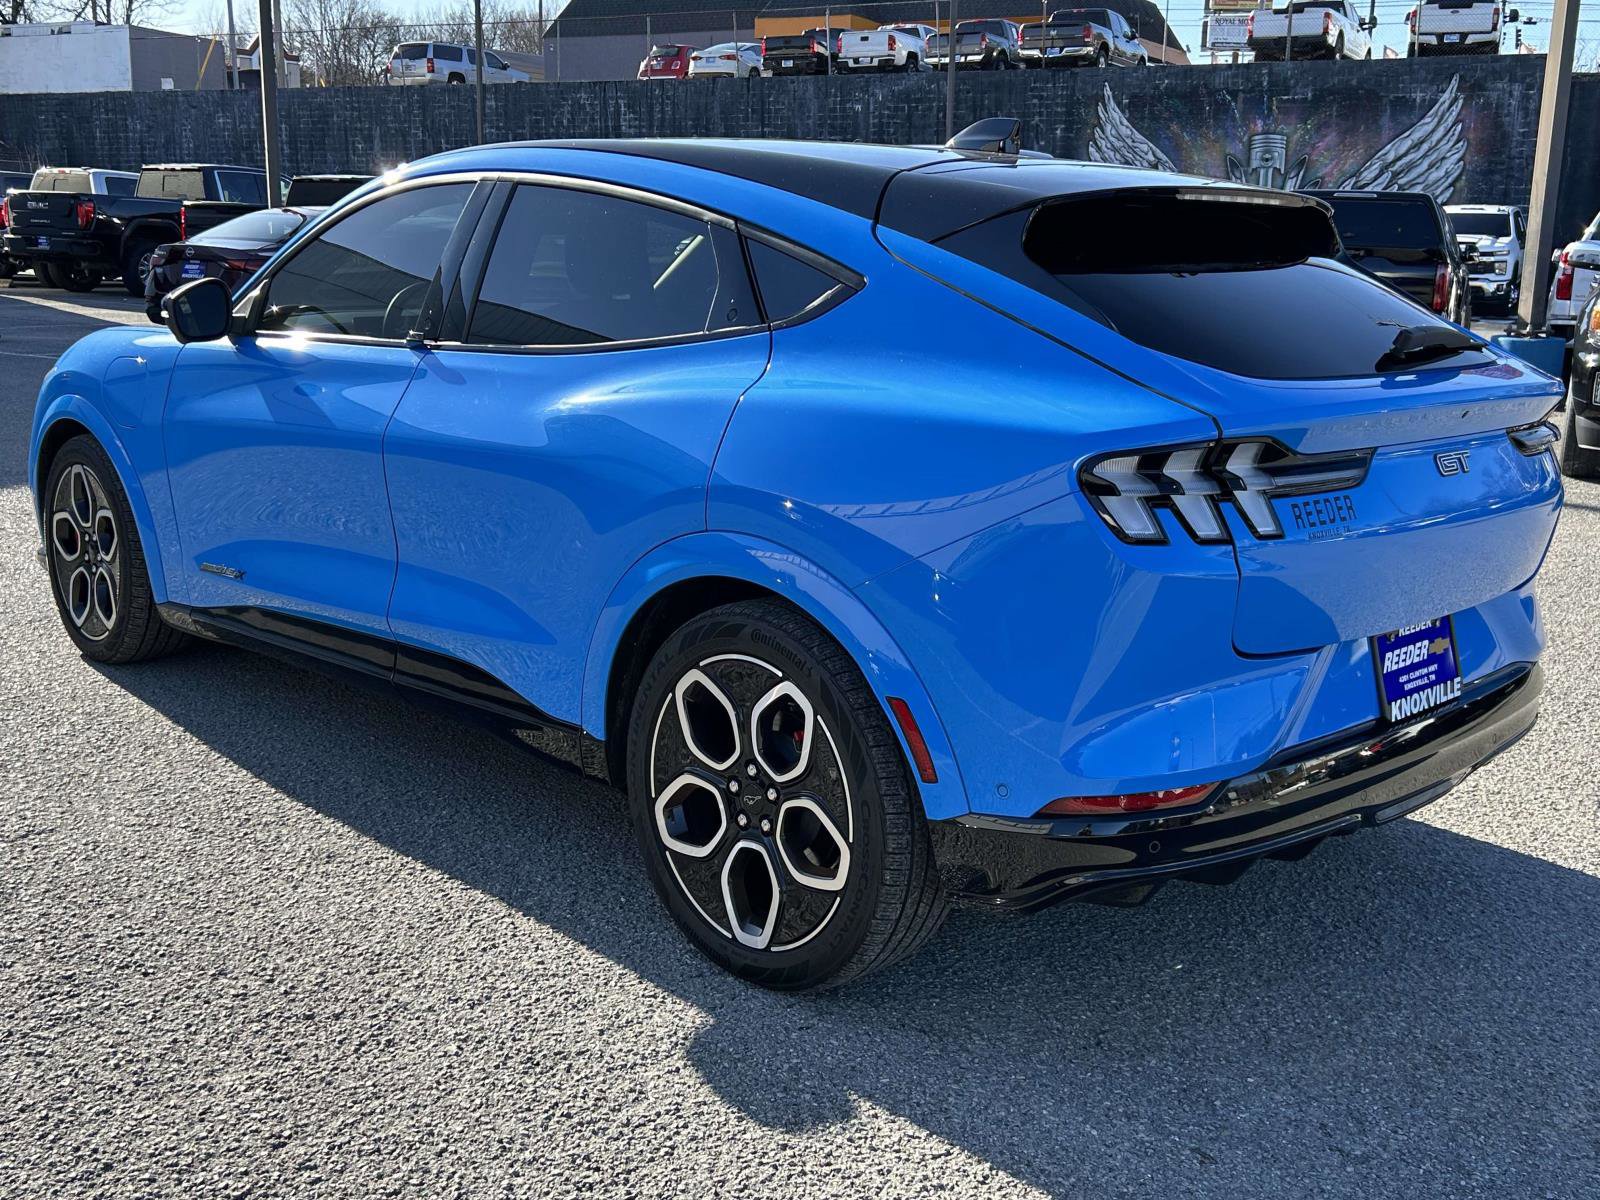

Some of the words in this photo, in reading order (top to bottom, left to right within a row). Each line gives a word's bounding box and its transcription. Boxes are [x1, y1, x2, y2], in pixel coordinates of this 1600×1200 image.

[27, 201, 49, 209] GMC
[1434, 450, 1470, 477] GT
[1290, 495, 1357, 529] REEDER
[750, 627, 808, 672] Continental
[1383, 639, 1429, 674] REEDER
[1391, 676, 1461, 722] KNOXVILLE
